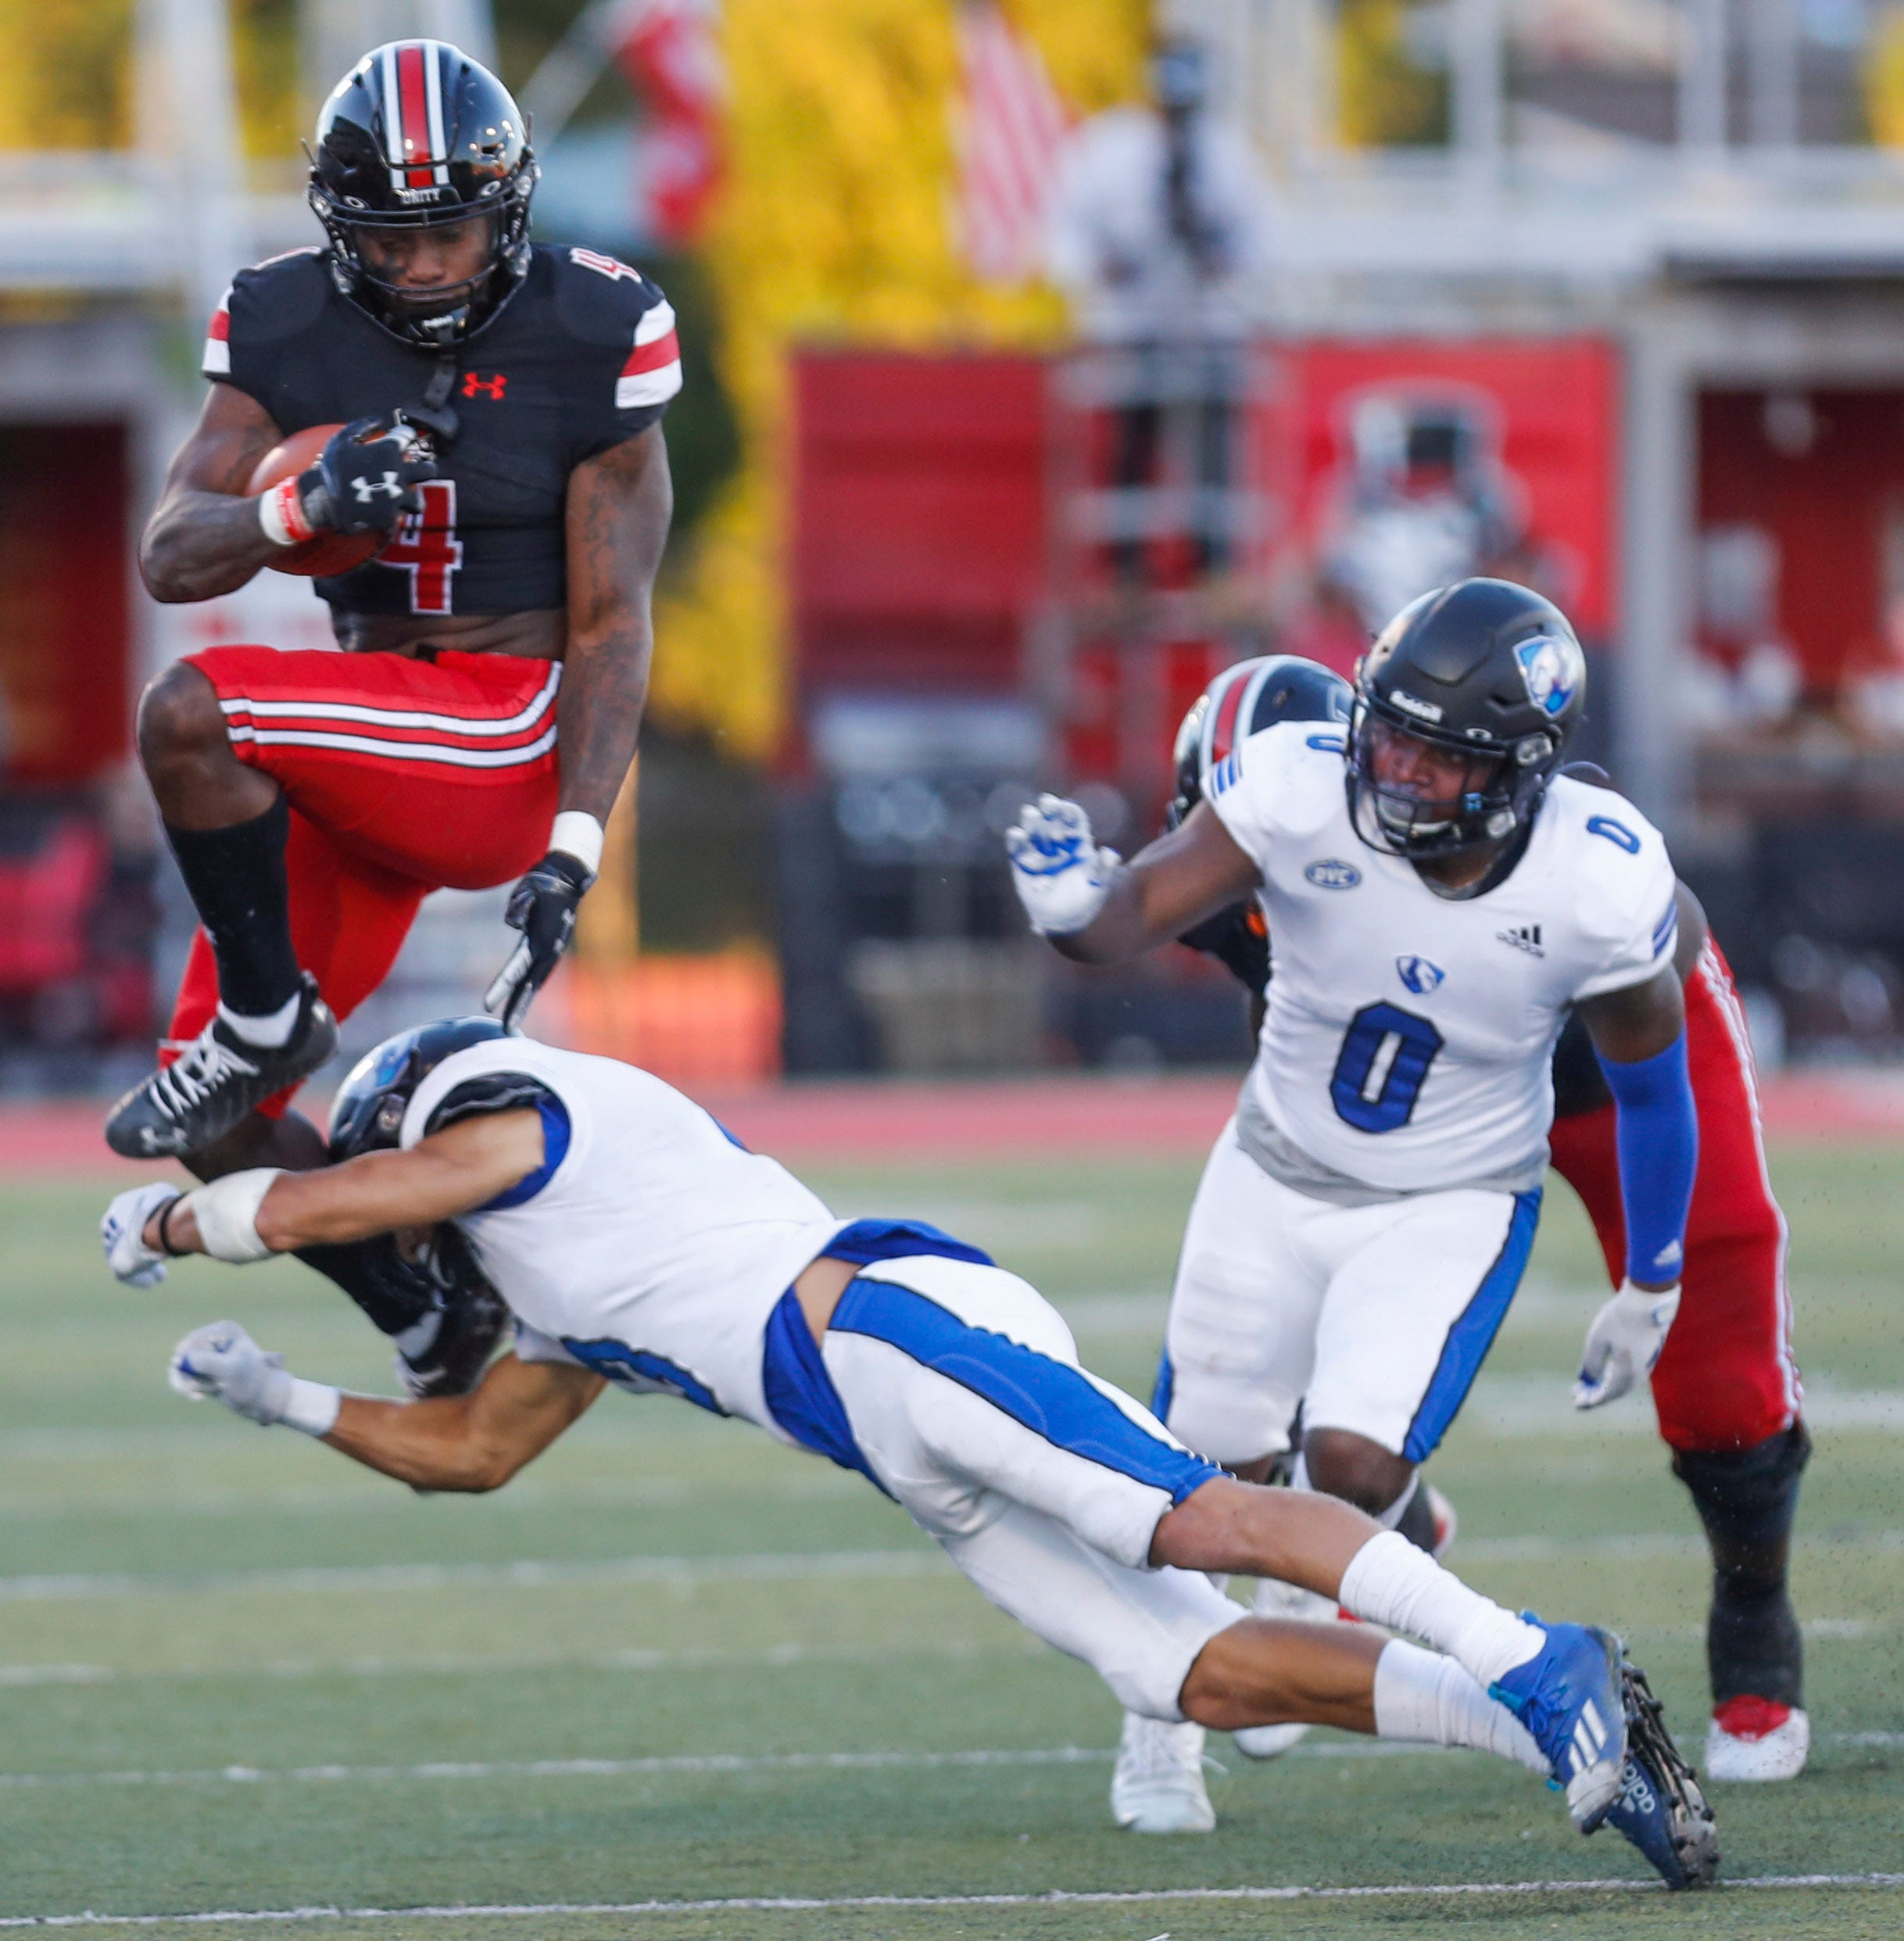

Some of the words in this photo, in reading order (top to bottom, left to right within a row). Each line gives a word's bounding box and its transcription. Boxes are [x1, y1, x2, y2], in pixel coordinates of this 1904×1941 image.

[374, 479, 463, 615] 4
[1586, 816, 1641, 854] 0
[1330, 999, 1445, 1134] 0
